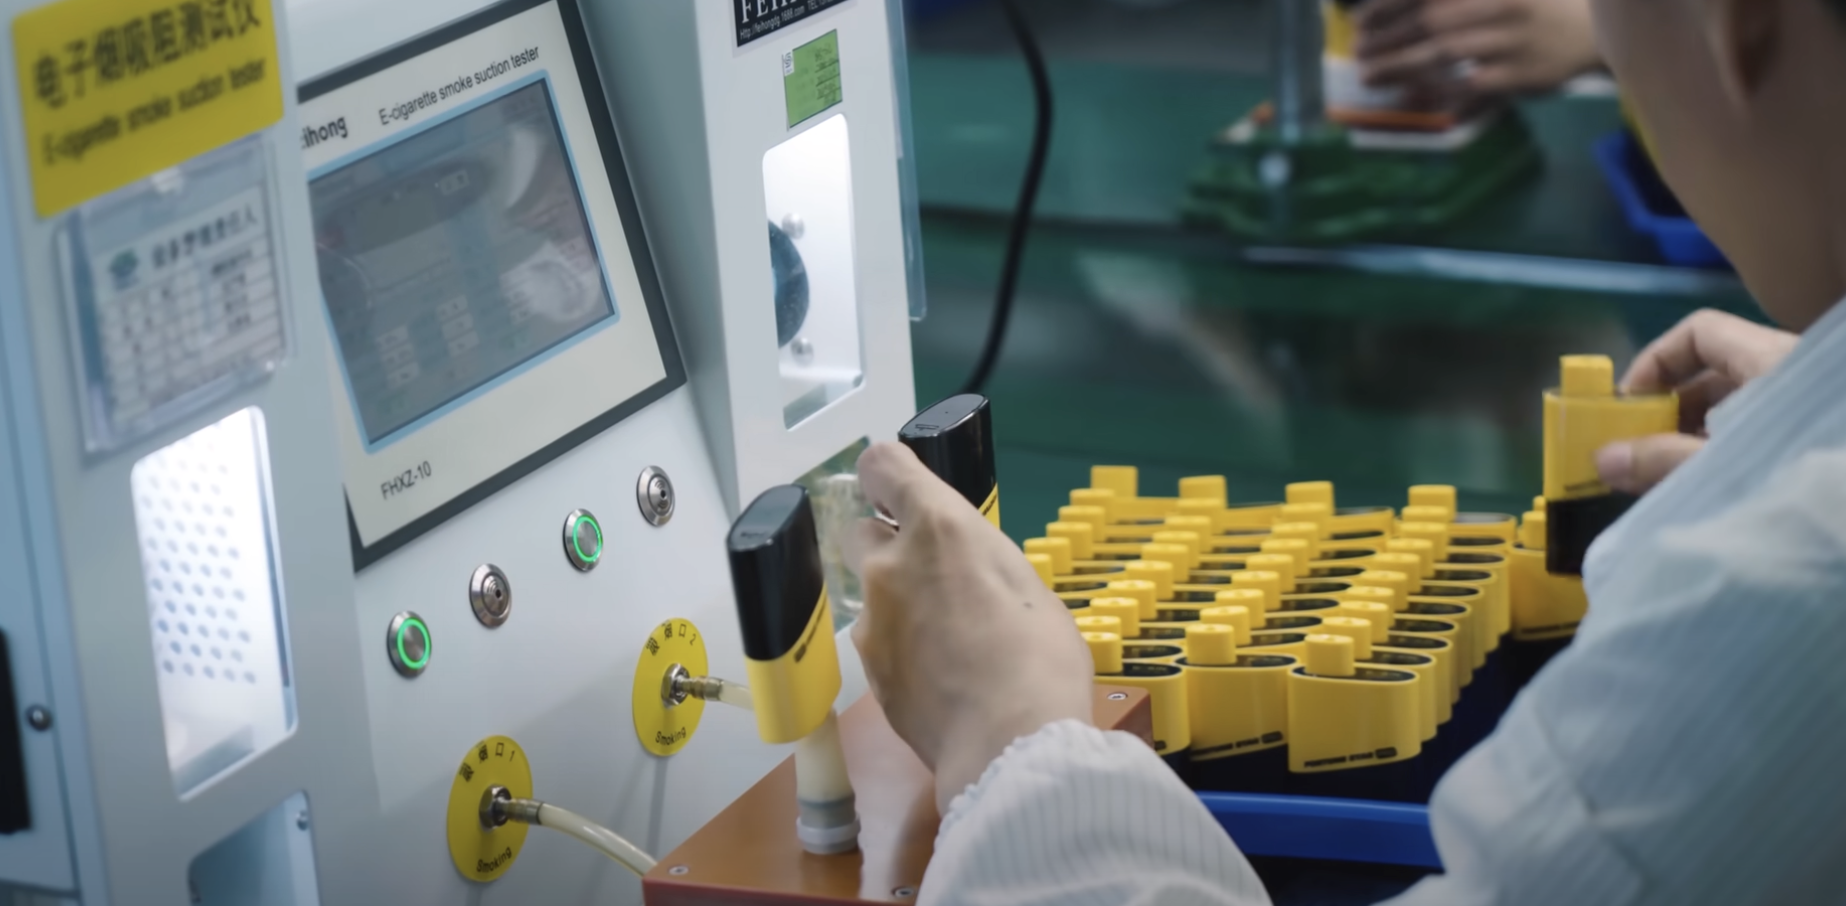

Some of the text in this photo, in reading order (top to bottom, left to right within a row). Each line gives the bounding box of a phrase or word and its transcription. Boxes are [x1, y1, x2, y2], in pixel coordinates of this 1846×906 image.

[378, 46, 540, 126] E-cigarette smoke suction tester
[380, 460, 432, 501] FHXZ-10
[655, 726, 687, 746] Smoking
[476, 846, 513, 873] Smoking
